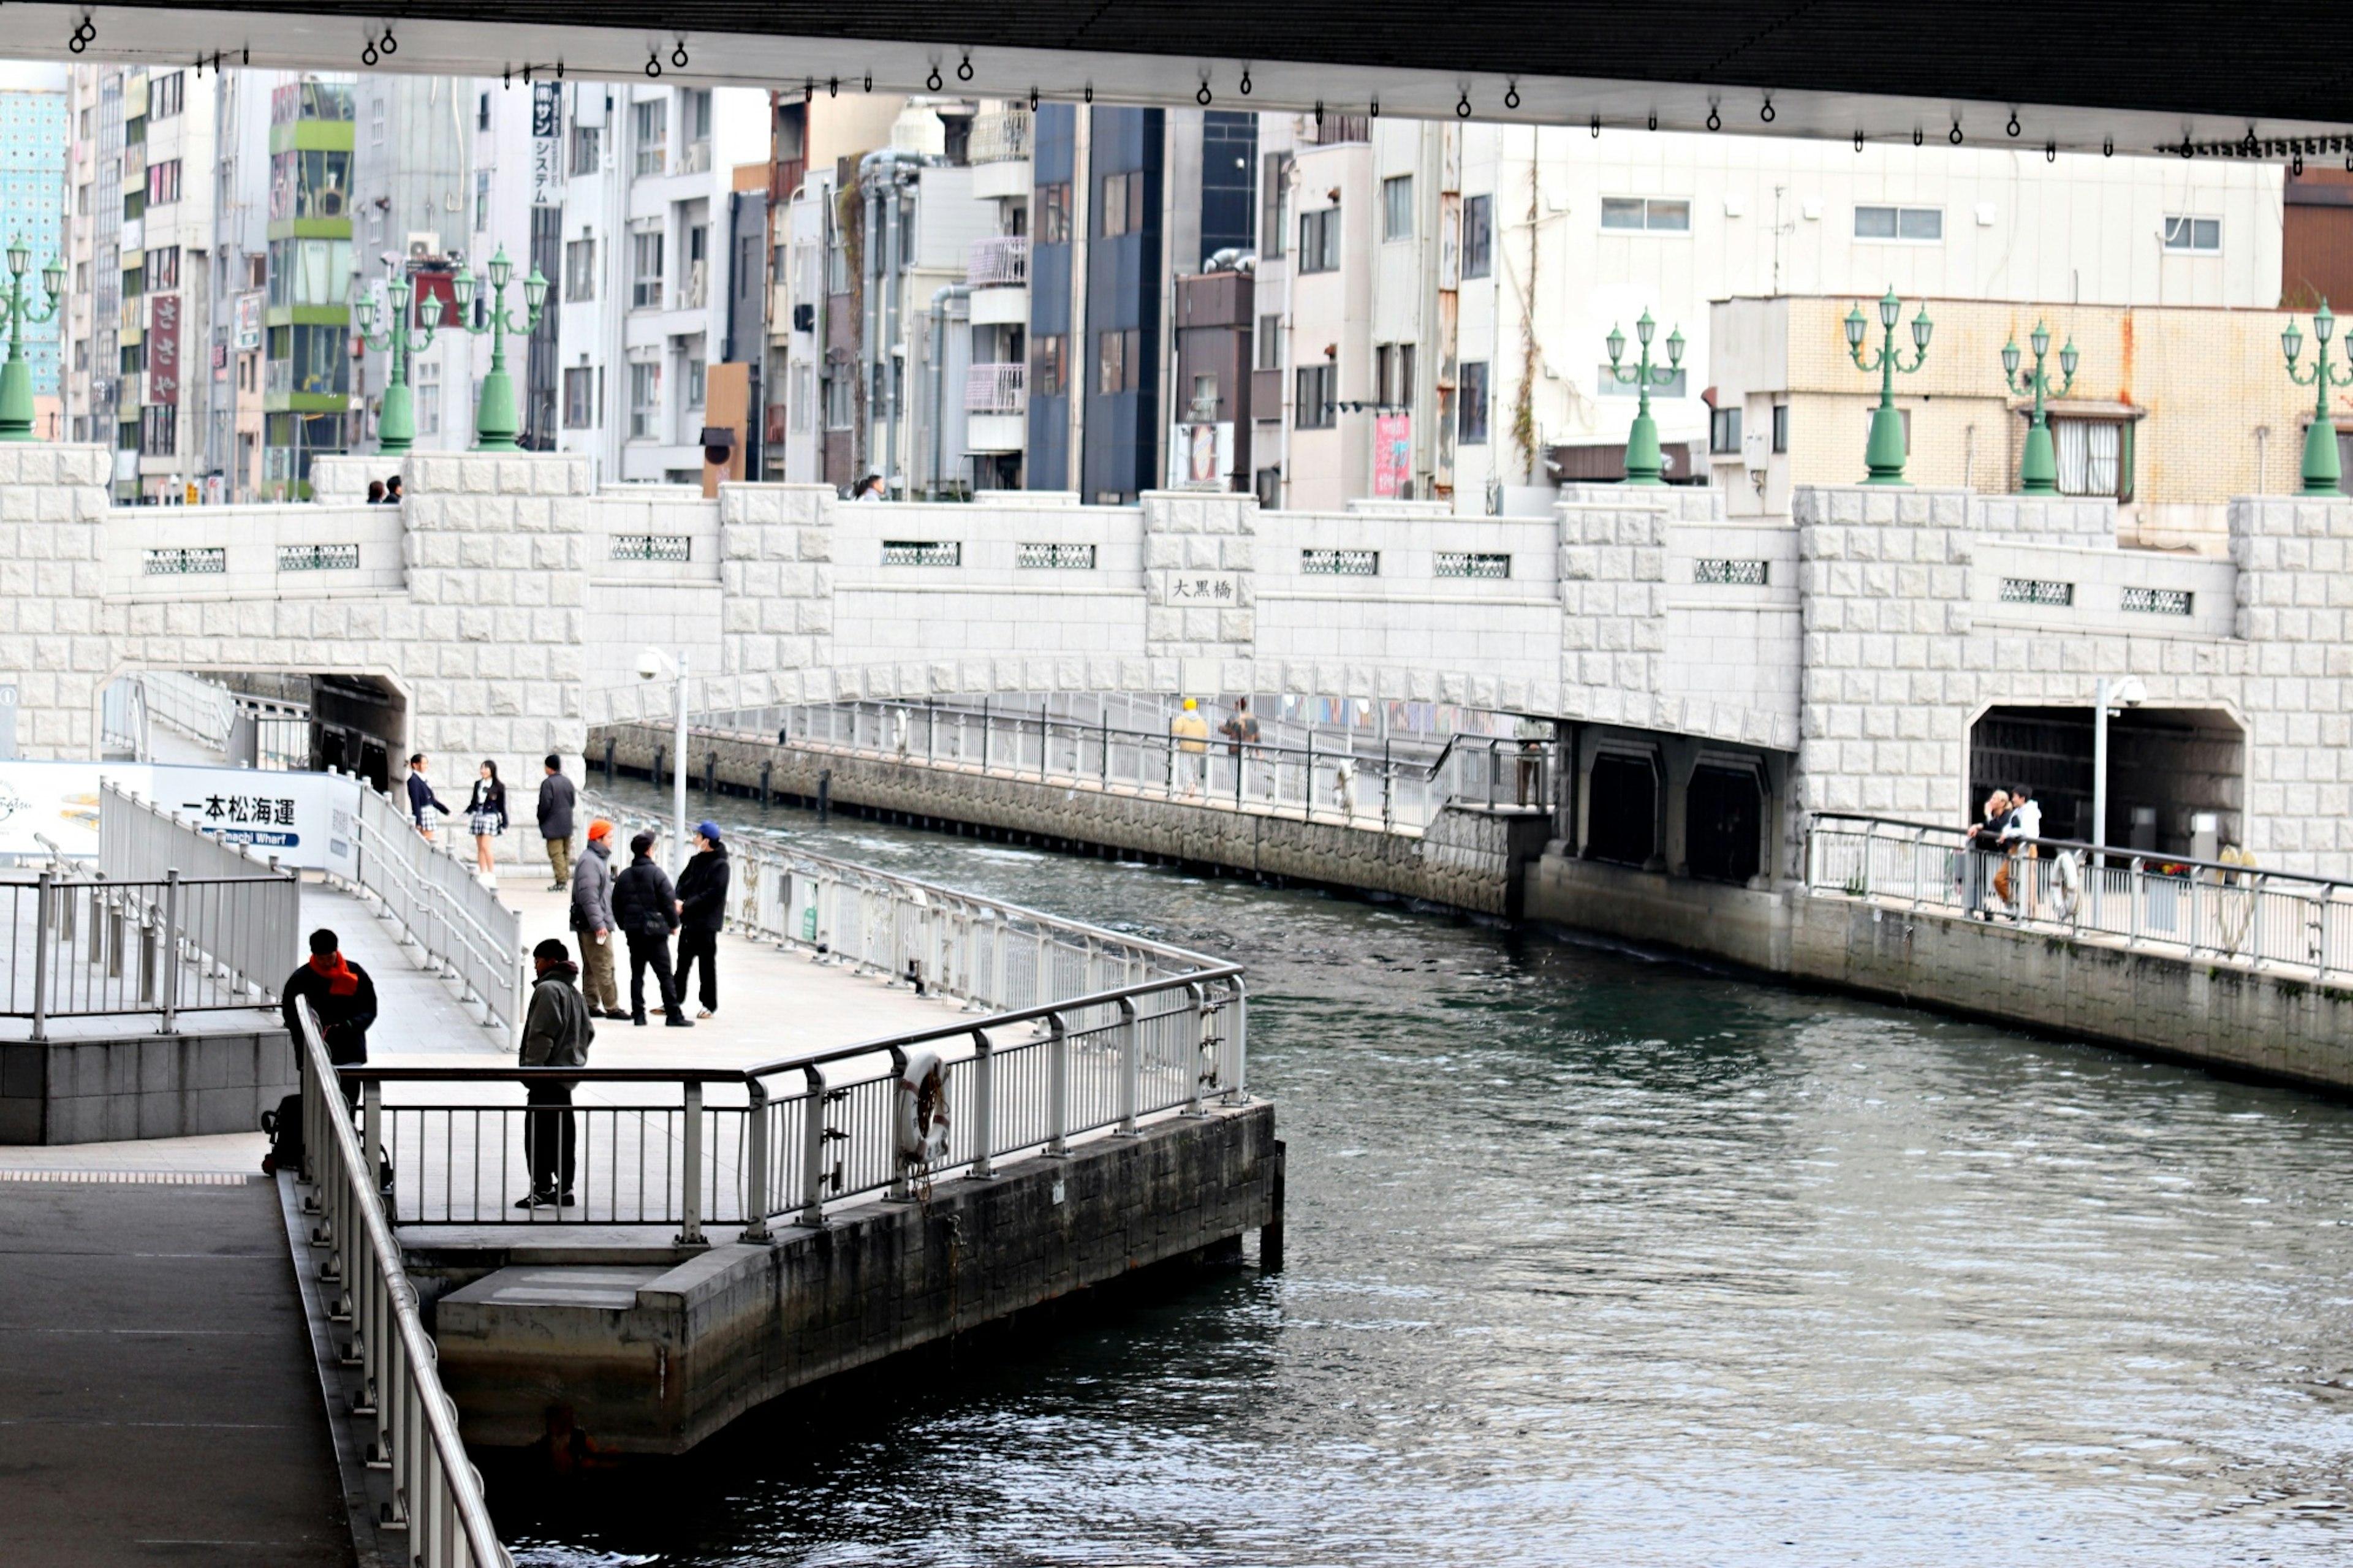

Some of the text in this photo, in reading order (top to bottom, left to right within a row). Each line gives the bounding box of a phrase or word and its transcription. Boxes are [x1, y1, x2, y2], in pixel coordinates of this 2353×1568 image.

[154, 302, 176, 398] ささや
[1173, 578, 1233, 600] 大黒橋
[183, 794, 295, 826] 一本松海運
[256, 833, 287, 846] Wharf
